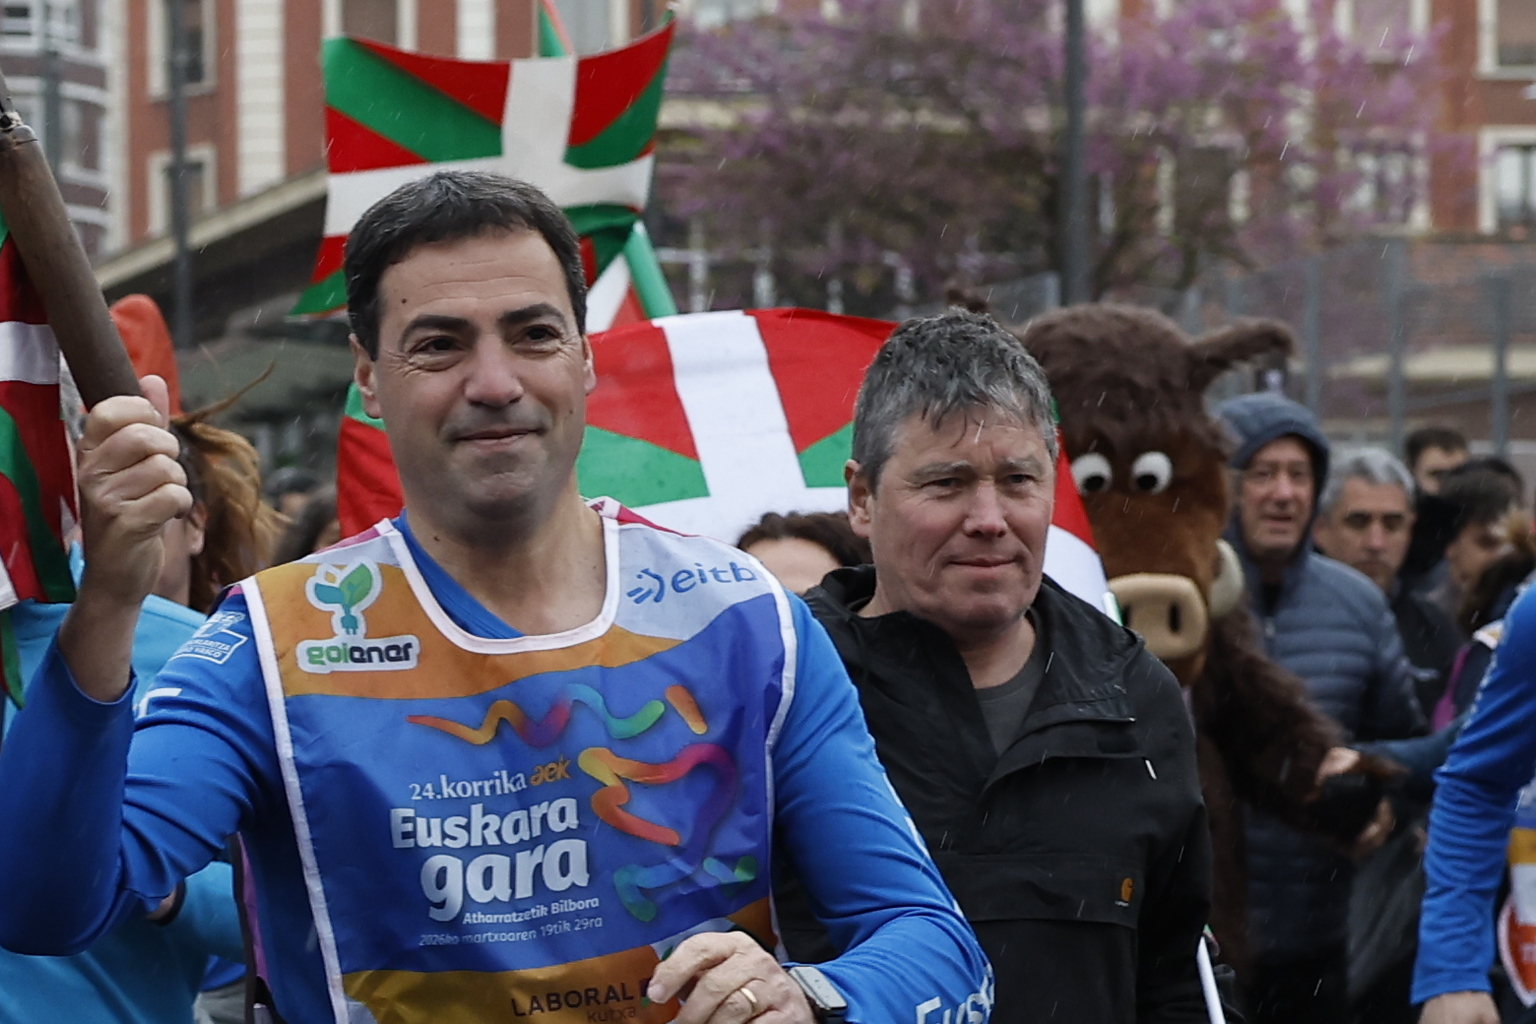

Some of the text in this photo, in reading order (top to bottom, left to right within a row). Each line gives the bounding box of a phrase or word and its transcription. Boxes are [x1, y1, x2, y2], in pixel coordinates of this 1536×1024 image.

[670, 561, 759, 594] eitb
[306, 641, 414, 666] goiener
[409, 754, 571, 799] 24.korrika aek
[391, 798, 579, 848] Euskara
[421, 839, 589, 921] gara
[462, 897, 600, 926] Atharratzetik Bilbora
[462, 928, 537, 946] martxoaren
[539, 918, 571, 938] 19tik
[574, 915, 604, 933] 29ra
[511, 981, 636, 1020] LABORAL
[586, 1003, 638, 1024] kutxa
